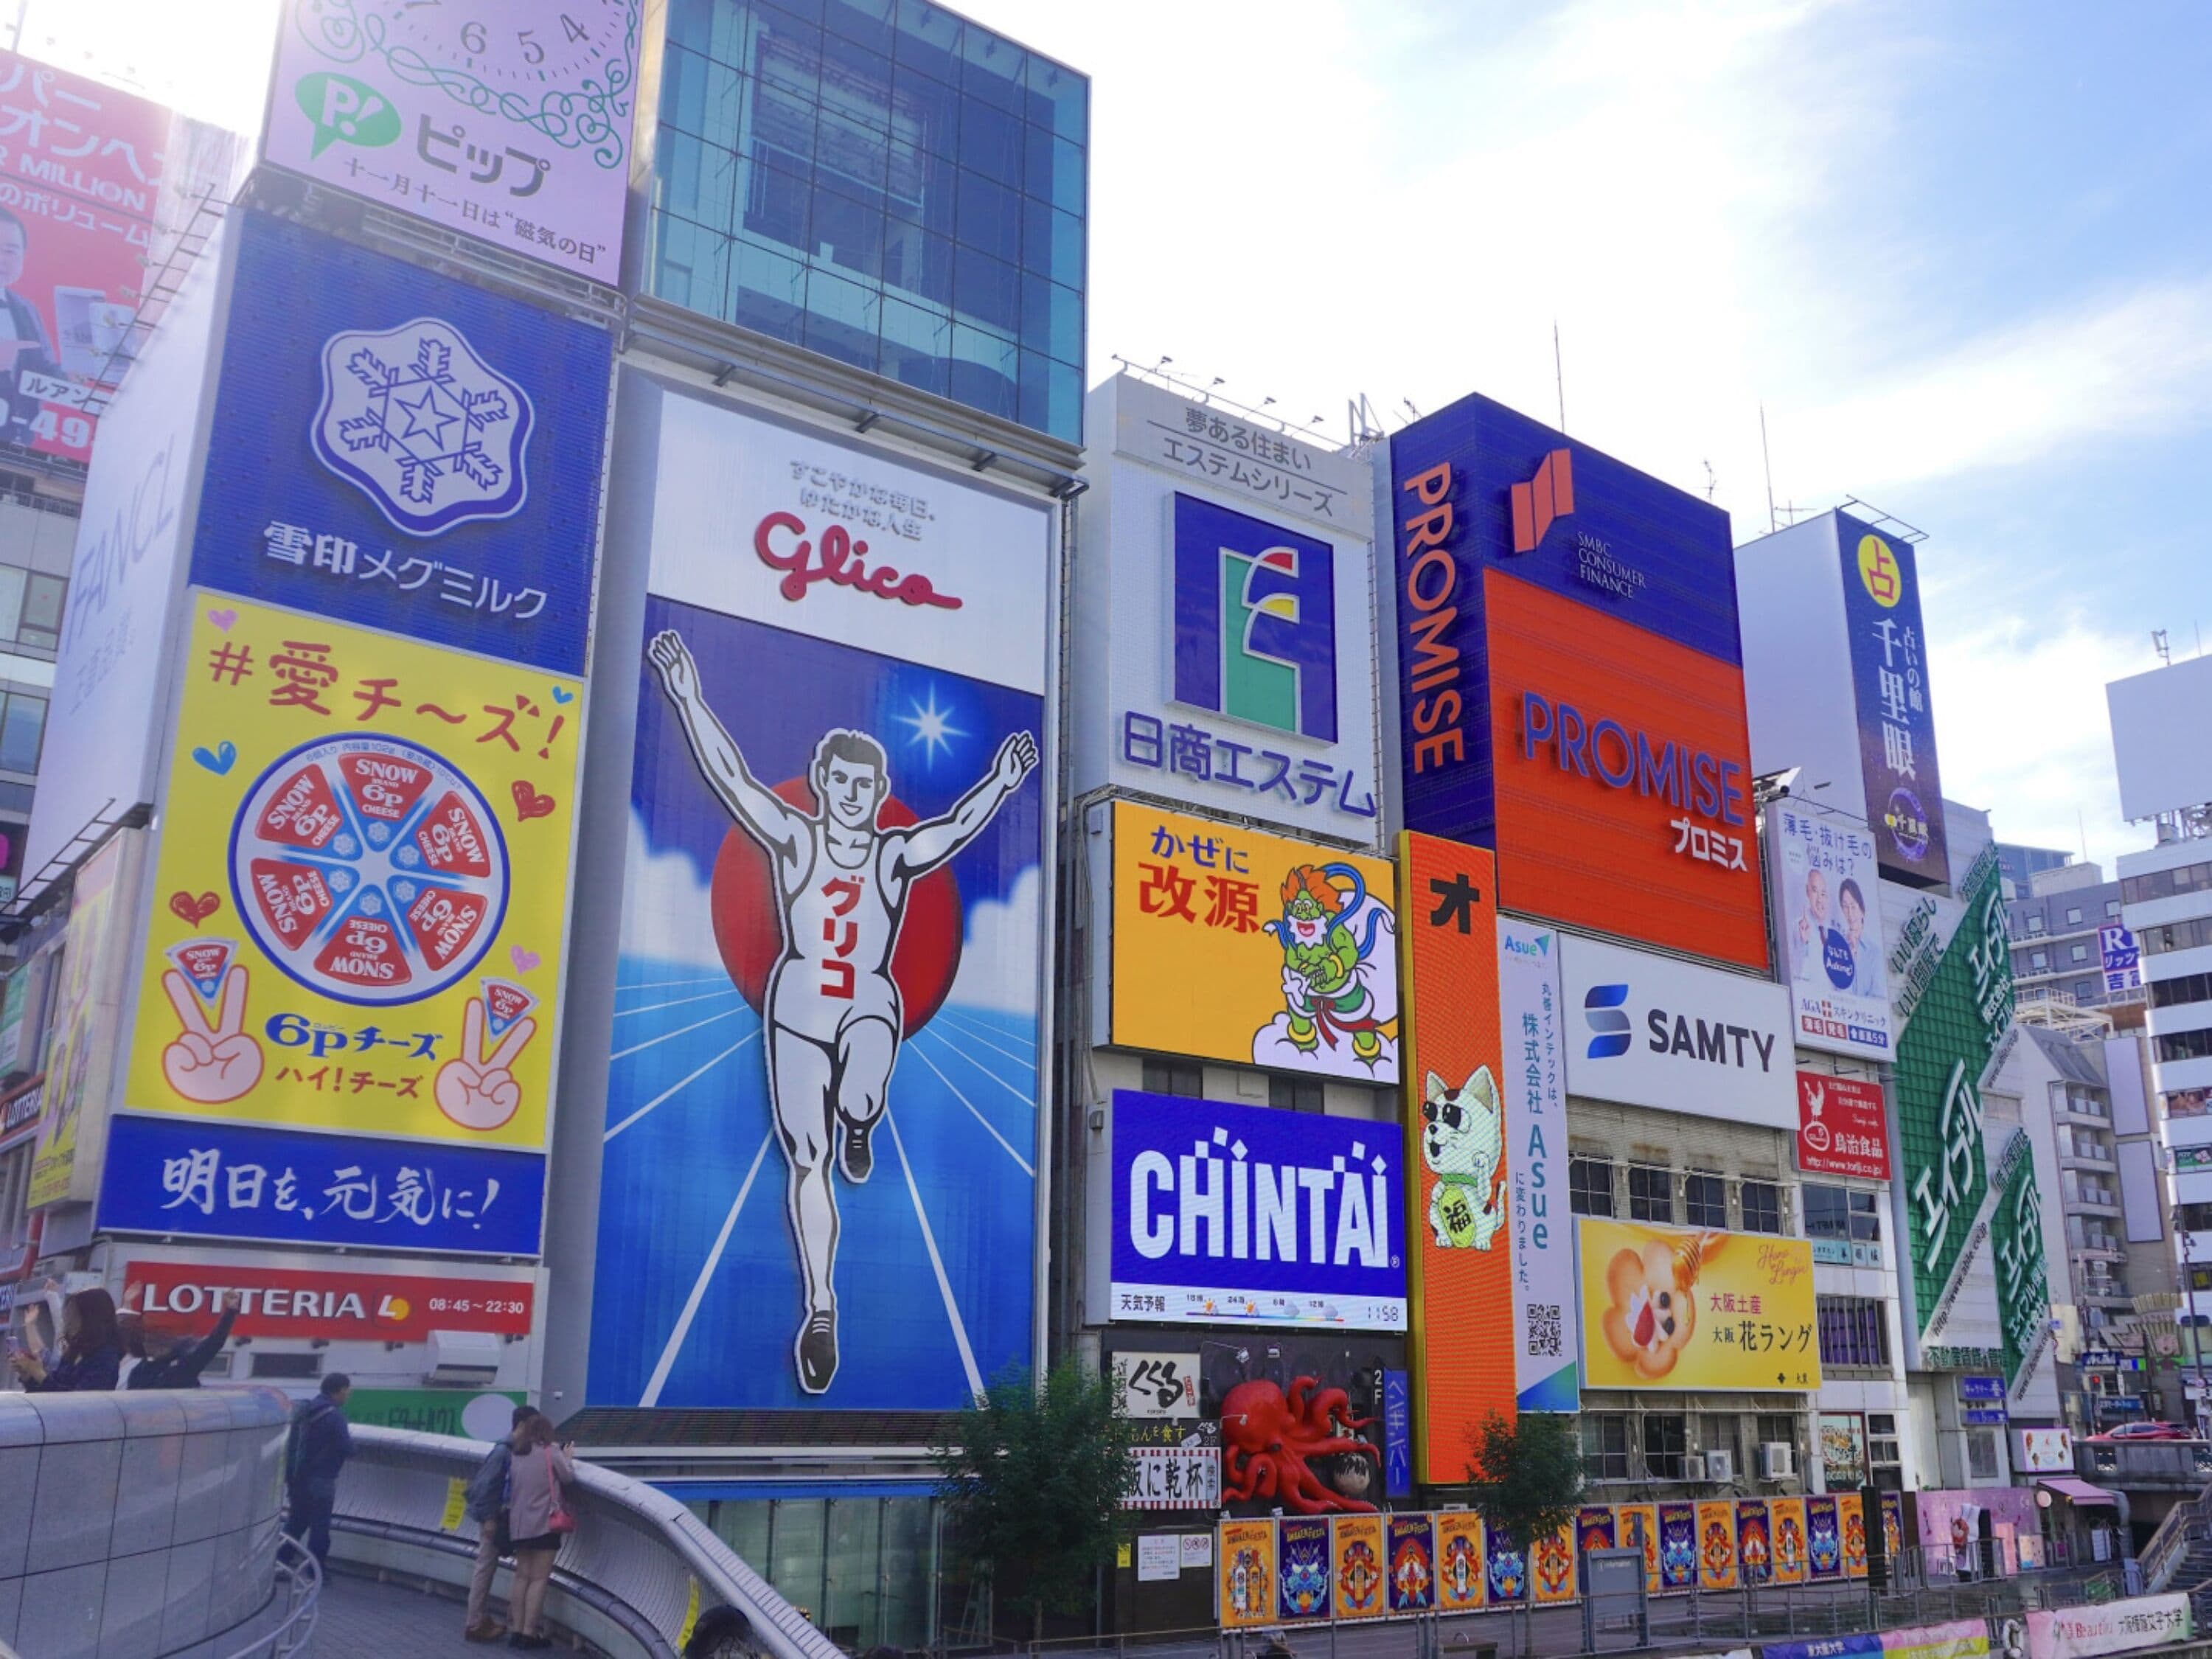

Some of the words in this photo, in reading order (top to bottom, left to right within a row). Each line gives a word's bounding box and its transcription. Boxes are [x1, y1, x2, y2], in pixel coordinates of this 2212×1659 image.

[459, 21, 488, 55] 6
[517, 29, 545, 64] 5
[559, 13, 590, 44] 4
[20, 152, 146, 212] MILLION
[417, 113, 551, 198] ピップ
[1185, 406, 1311, 470] 夢ある住まい
[1164, 436, 1333, 516] エステムシリーズ
[799, 487, 922, 540] ゆたかな人生
[263, 519, 547, 619] 雪印メグミルク
[754, 510, 963, 610] Glico
[1577, 531, 1613, 558] SMBC
[1577, 547, 1647, 589] CONSUMER
[1867, 538, 1896, 601] 占
[1578, 564, 1635, 599] FINANCE
[1403, 461, 1465, 774] PROMISE
[1871, 617, 1916, 781] 千里眼
[355, 757, 419, 785] SNOW
[1123, 710, 1377, 818] 日商エステム
[1522, 690, 1745, 827] PROMISE
[266, 774, 316, 830] SNOW
[361, 804, 400, 818] CHEESE
[310, 814, 340, 846] CHEESE
[417, 830, 439, 867] CHEESE
[448, 806, 485, 865] SNOW
[1149, 824, 1251, 874] かぜに
[1670, 815, 1748, 872] プロミス
[256, 872, 298, 934] SNOW
[307, 869, 330, 908] CHEESE
[409, 889, 437, 922] CHEESE
[1137, 861, 1260, 934] 改源
[1429, 873, 1481, 935] オ
[349, 919, 389, 933] CHEESE
[434, 905, 479, 960] SNOW
[820, 874, 866, 1001] グリコ
[1505, 934, 1537, 956] Asue
[329, 956, 396, 980] SNOW
[1522, 1011, 1543, 1115] 株式会社
[1647, 1008, 1775, 1073] SAMTY
[274, 1065, 425, 1099] ハイ!チーズ
[160, 1147, 500, 1231] 明日を、元気に!
[1528, 1124, 1548, 1251] Asue
[1515, 1172, 1531, 1291] に変わりました。
[143, 1282, 366, 1320] LOTTERIA
[1120, 1294, 1166, 1312] 天気予報
[1709, 1293, 1761, 1315] 大阪土産
[1712, 1326, 1735, 1343] 大阪
[1738, 1320, 1812, 1354] 花ラング
[1128, 1360, 1184, 1409] くくる
